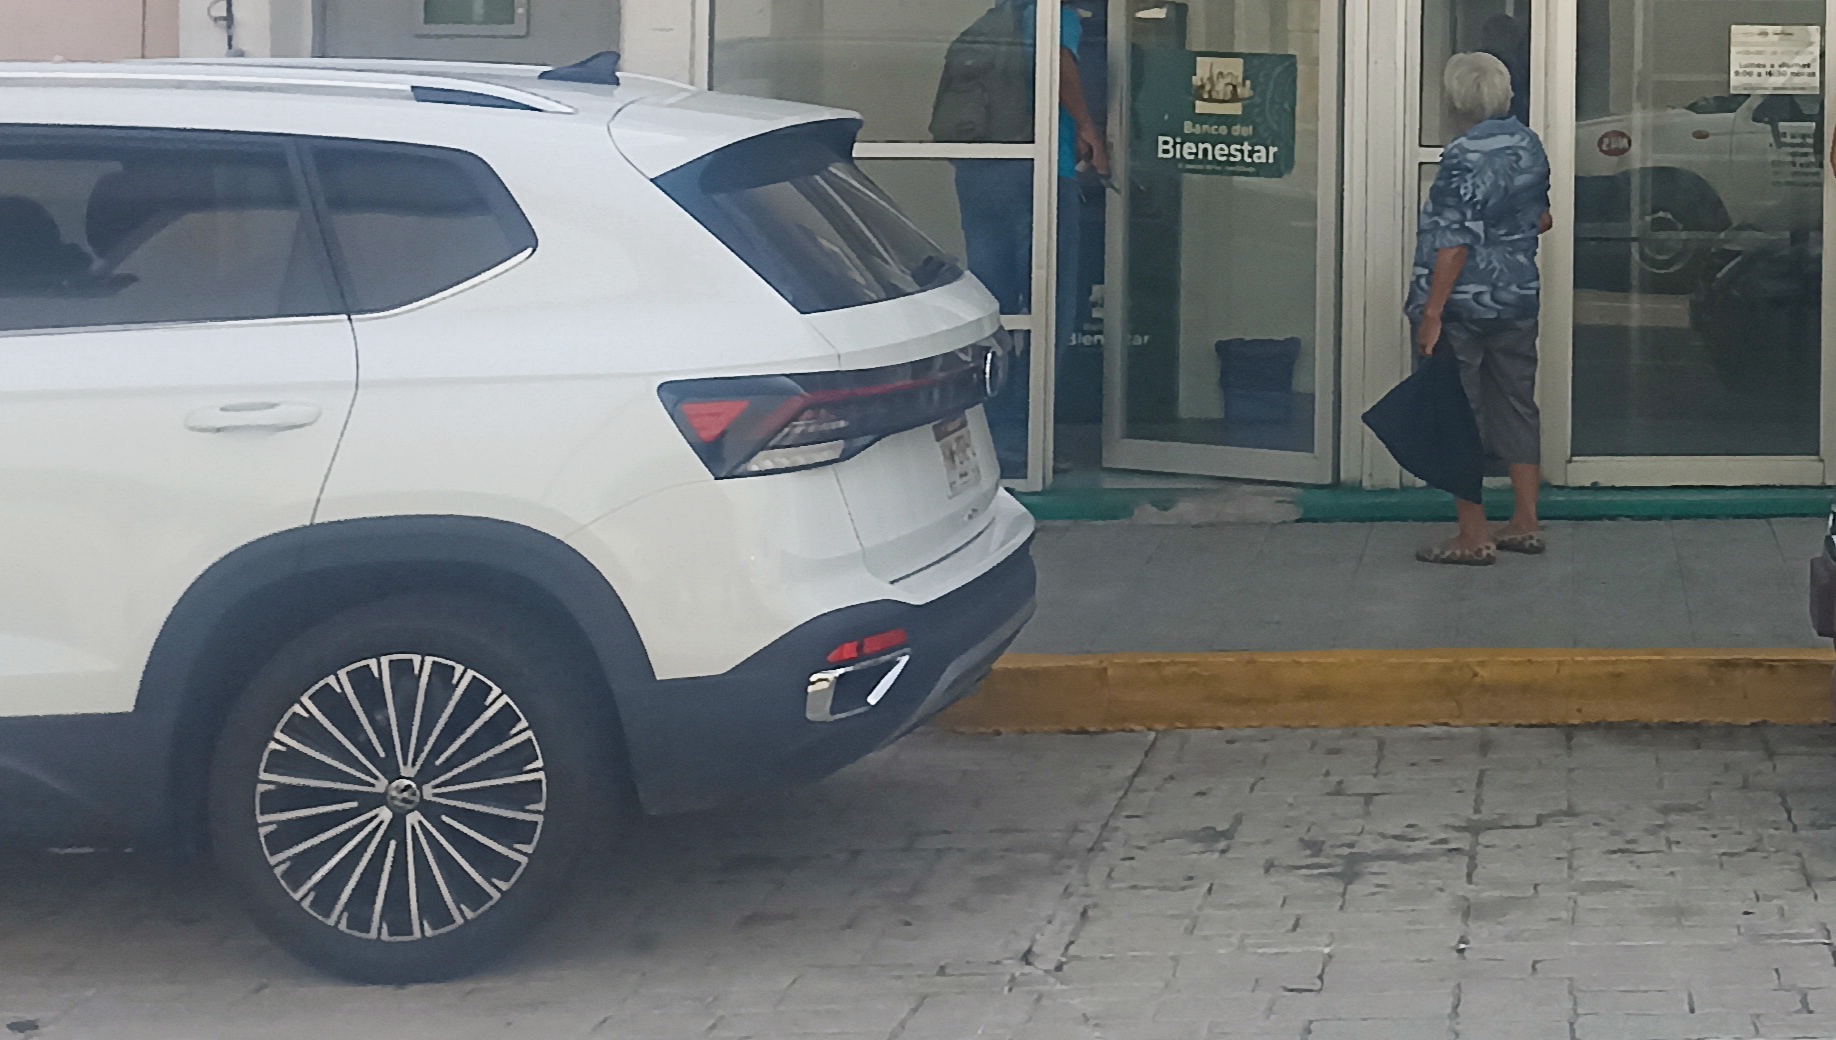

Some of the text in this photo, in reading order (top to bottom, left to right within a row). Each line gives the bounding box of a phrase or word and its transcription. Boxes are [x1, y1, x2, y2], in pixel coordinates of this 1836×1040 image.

[1183, 120, 1253, 136] Banco del
[1157, 135, 1278, 163] Bienestar
